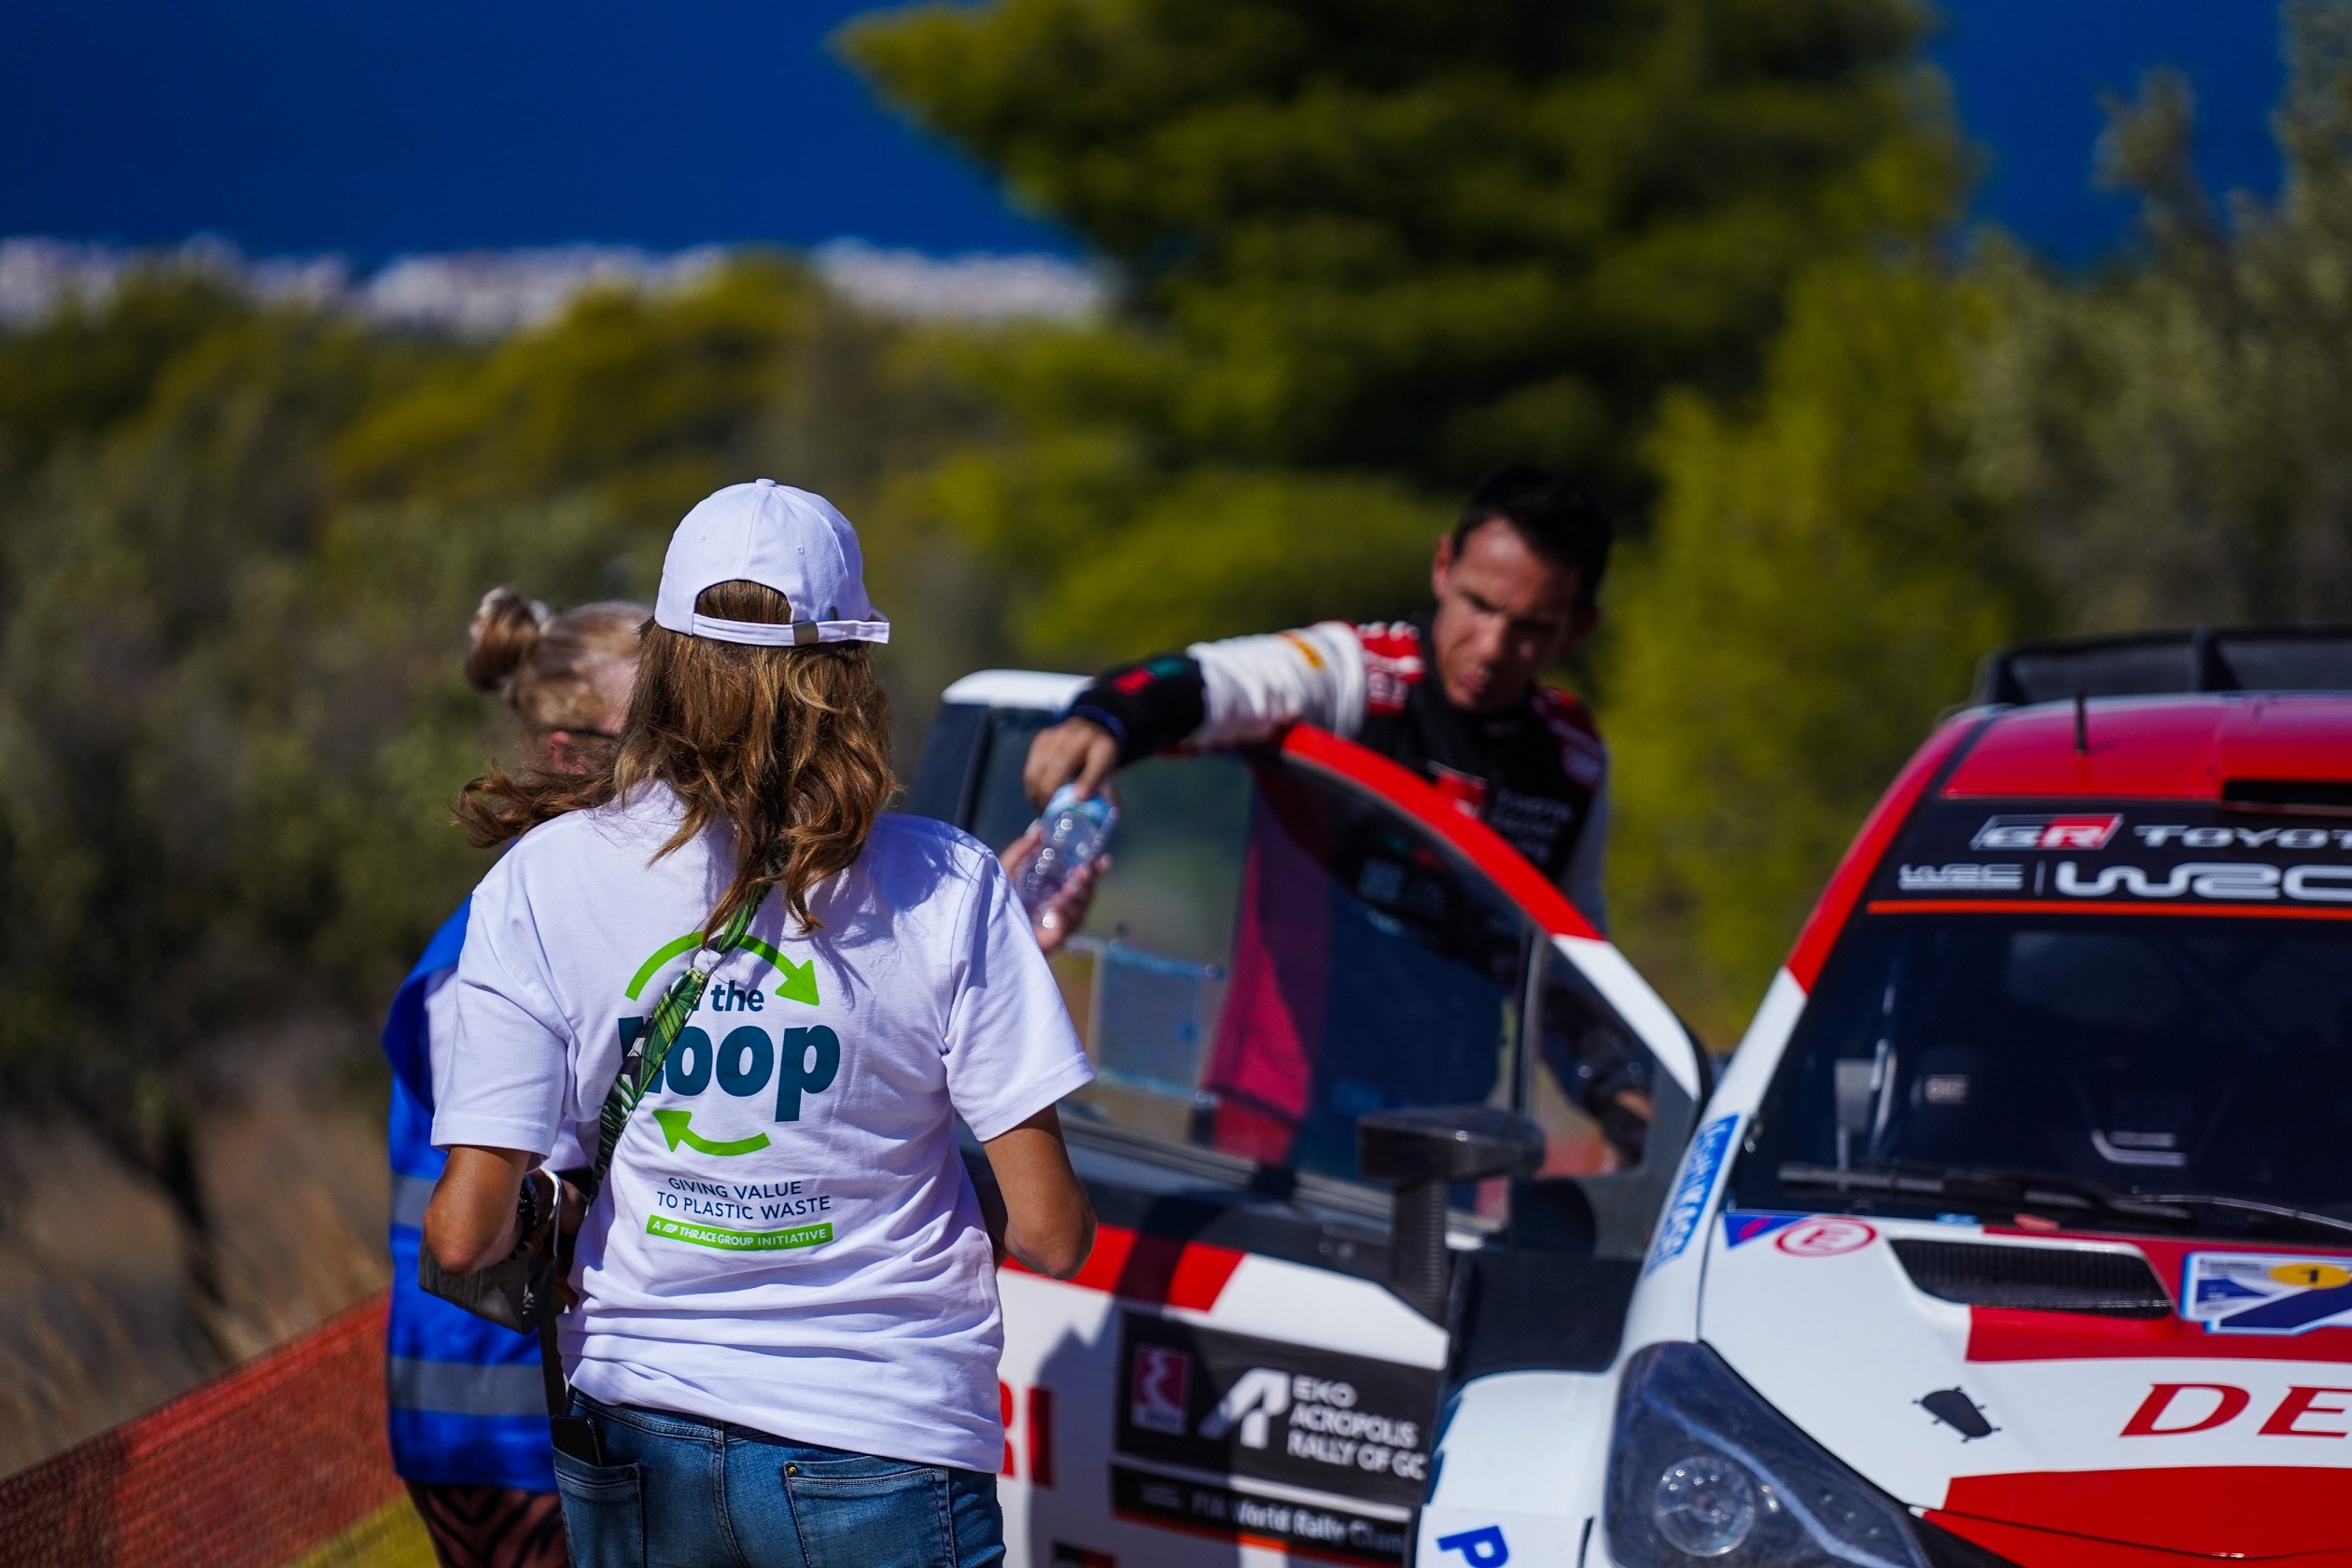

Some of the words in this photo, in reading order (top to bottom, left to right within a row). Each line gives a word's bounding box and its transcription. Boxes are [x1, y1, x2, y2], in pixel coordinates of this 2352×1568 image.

[1981, 825, 2104, 848] GR
[710, 980, 764, 1012] the
[668, 1177, 729, 1198] GIVING
[734, 1180, 803, 1200] VALUE
[657, 1191, 679, 1209] TO
[683, 1197, 754, 1220] PLASTIC
[761, 1195, 831, 1220] WASTE
[651, 1220, 661, 1231] A
[679, 1226, 717, 1243] THRACE
[718, 1233, 754, 1246] GROUP
[757, 1228, 827, 1246] INITIATIVE
[2299, 1268, 2319, 1283] 1
[1292, 1375, 1358, 1408] EKO
[1290, 1404, 1420, 1449] ACROPOLIS
[2119, 1382, 2352, 1439] DE
[1287, 1429, 1354, 1466] RALLY
[1357, 1443, 1392, 1474] OF
[1234, 1499, 1292, 1533] World
[1293, 1508, 1345, 1547] Rally
